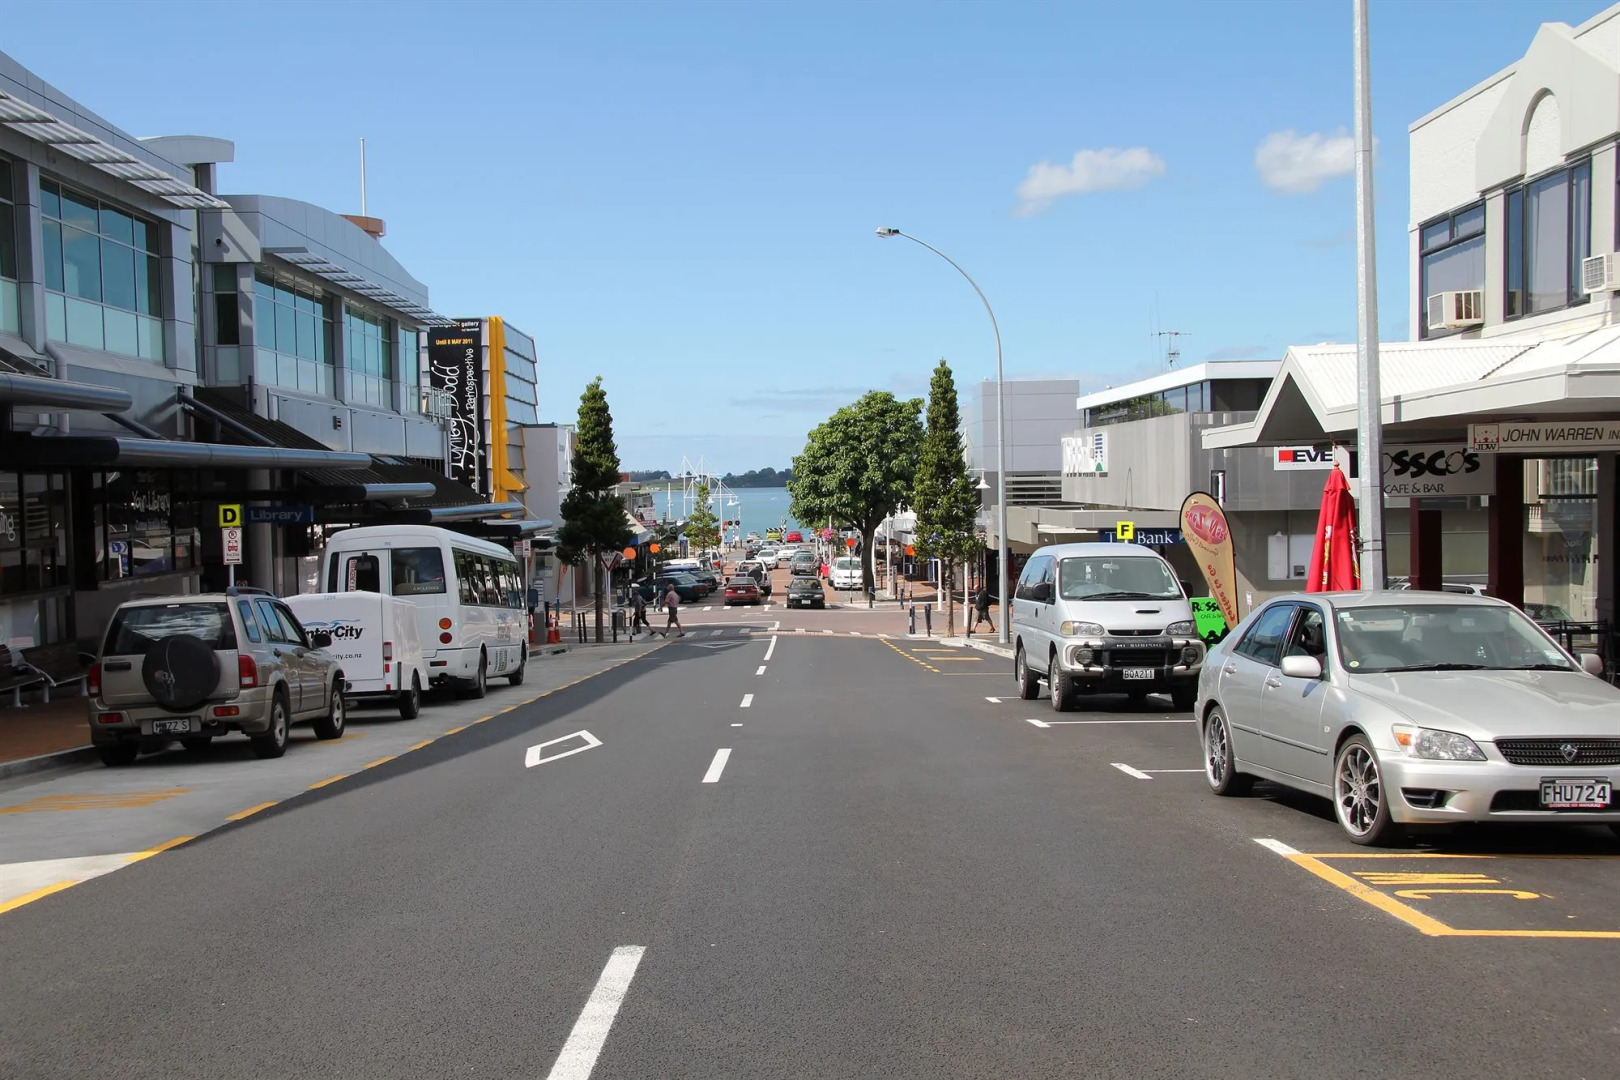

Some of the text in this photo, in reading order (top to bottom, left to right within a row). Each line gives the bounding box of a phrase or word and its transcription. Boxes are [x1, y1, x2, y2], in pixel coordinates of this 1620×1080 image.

[1502, 427, 1620, 442] JOHN WARREN IN
[1475, 442, 1497, 451] JDW
[1382, 448, 1481, 478] OSSCO'S
[1384, 484, 1444, 494] CAFE & BAR
[223, 508, 236, 523] D
[250, 510, 302, 522] Library
[1120, 524, 1130, 536] F
[1137, 530, 1174, 544] Bank
[1543, 786, 1607, 802] FHU724
